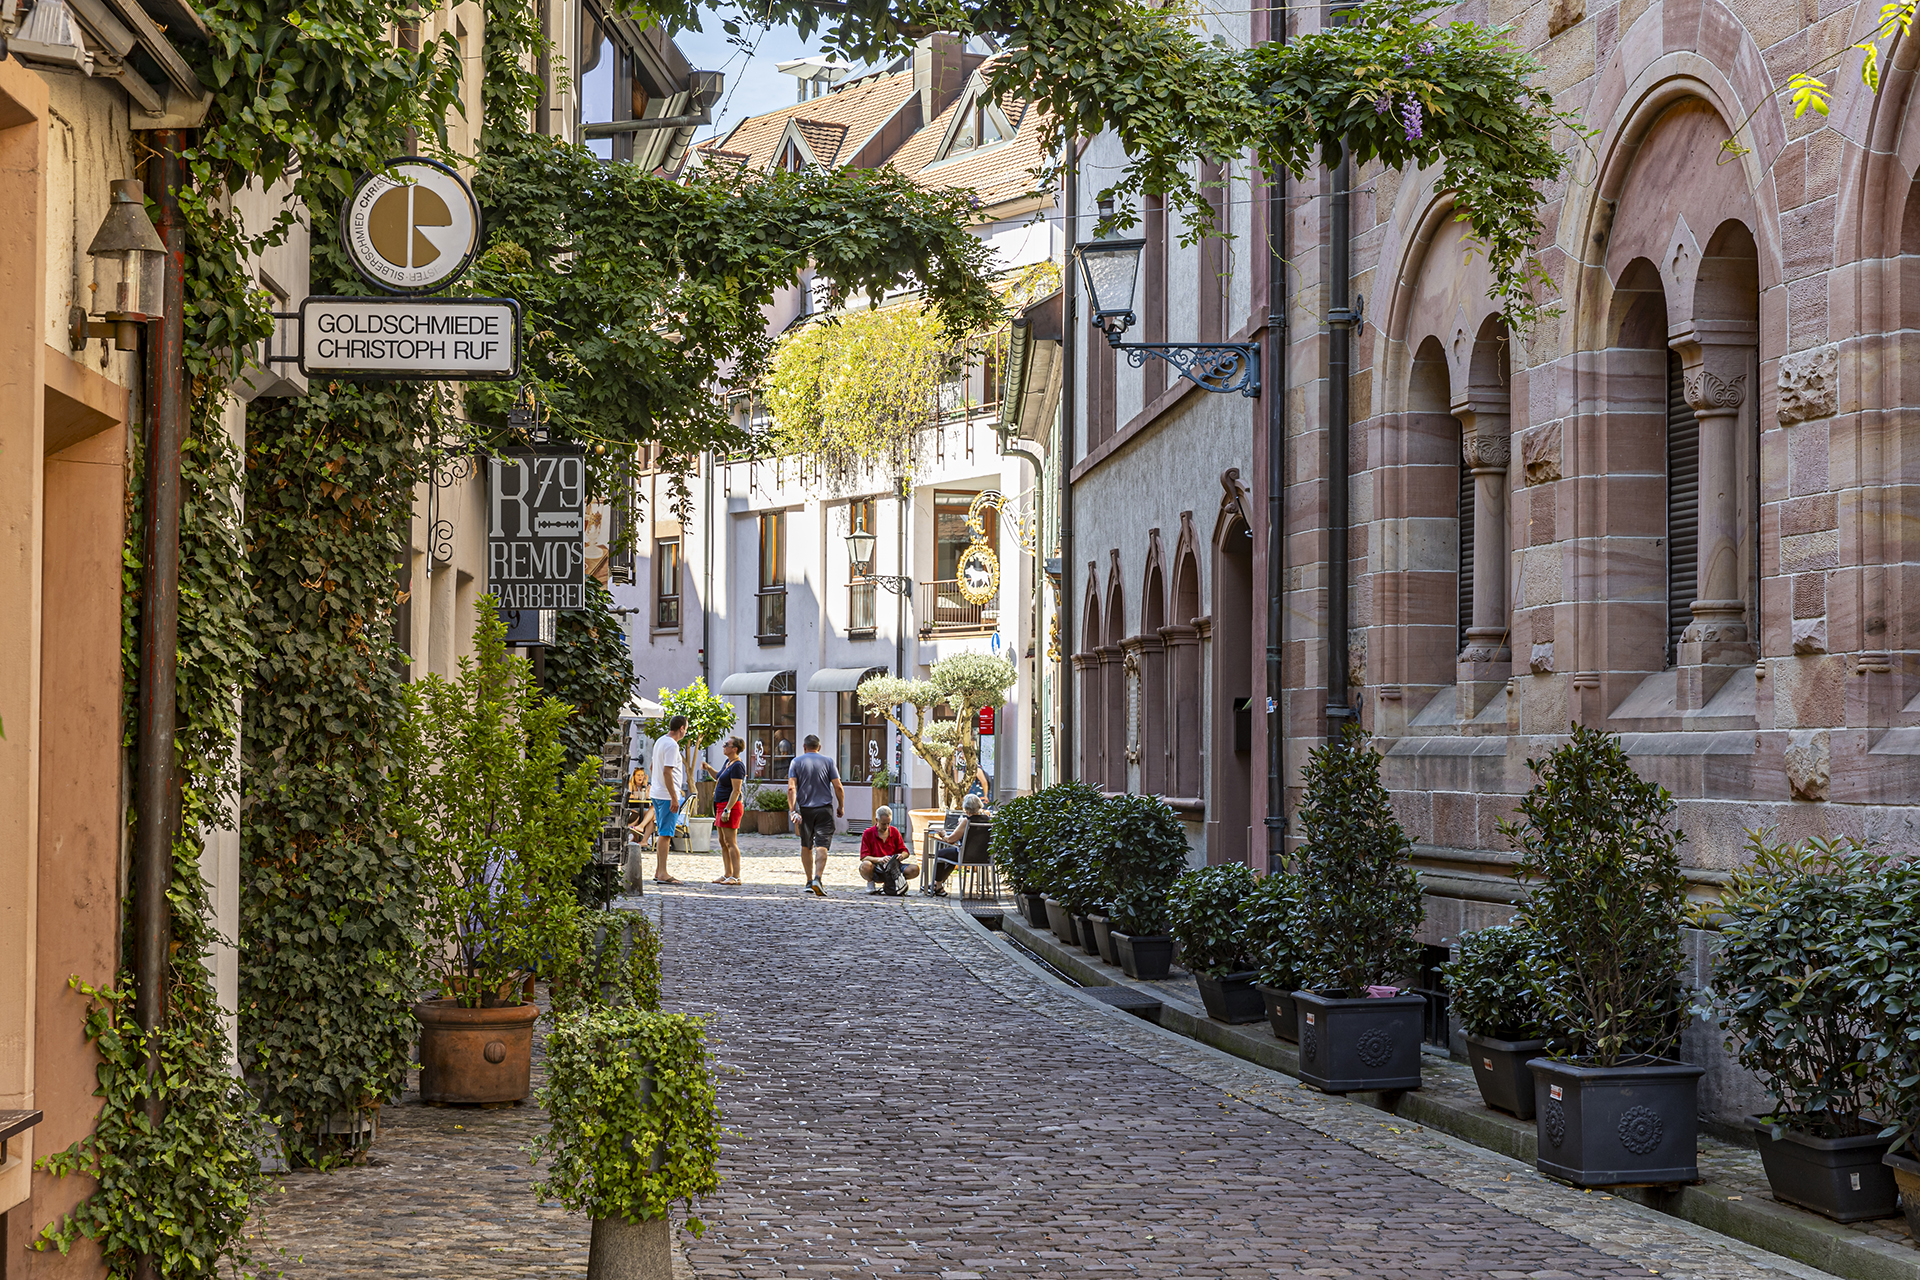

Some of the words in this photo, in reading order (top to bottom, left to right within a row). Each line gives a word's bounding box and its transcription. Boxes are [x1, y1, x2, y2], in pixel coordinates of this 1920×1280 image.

[359, 179, 386, 208] CHRIS
[355, 213, 405, 281] SILBERSCHMIED
[318, 314, 499, 335] GOLDSCHMIEDE
[317, 339, 446, 359] CHRISTOPH
[454, 341, 499, 360] RUF
[489, 583, 583, 608] BARBEREI
